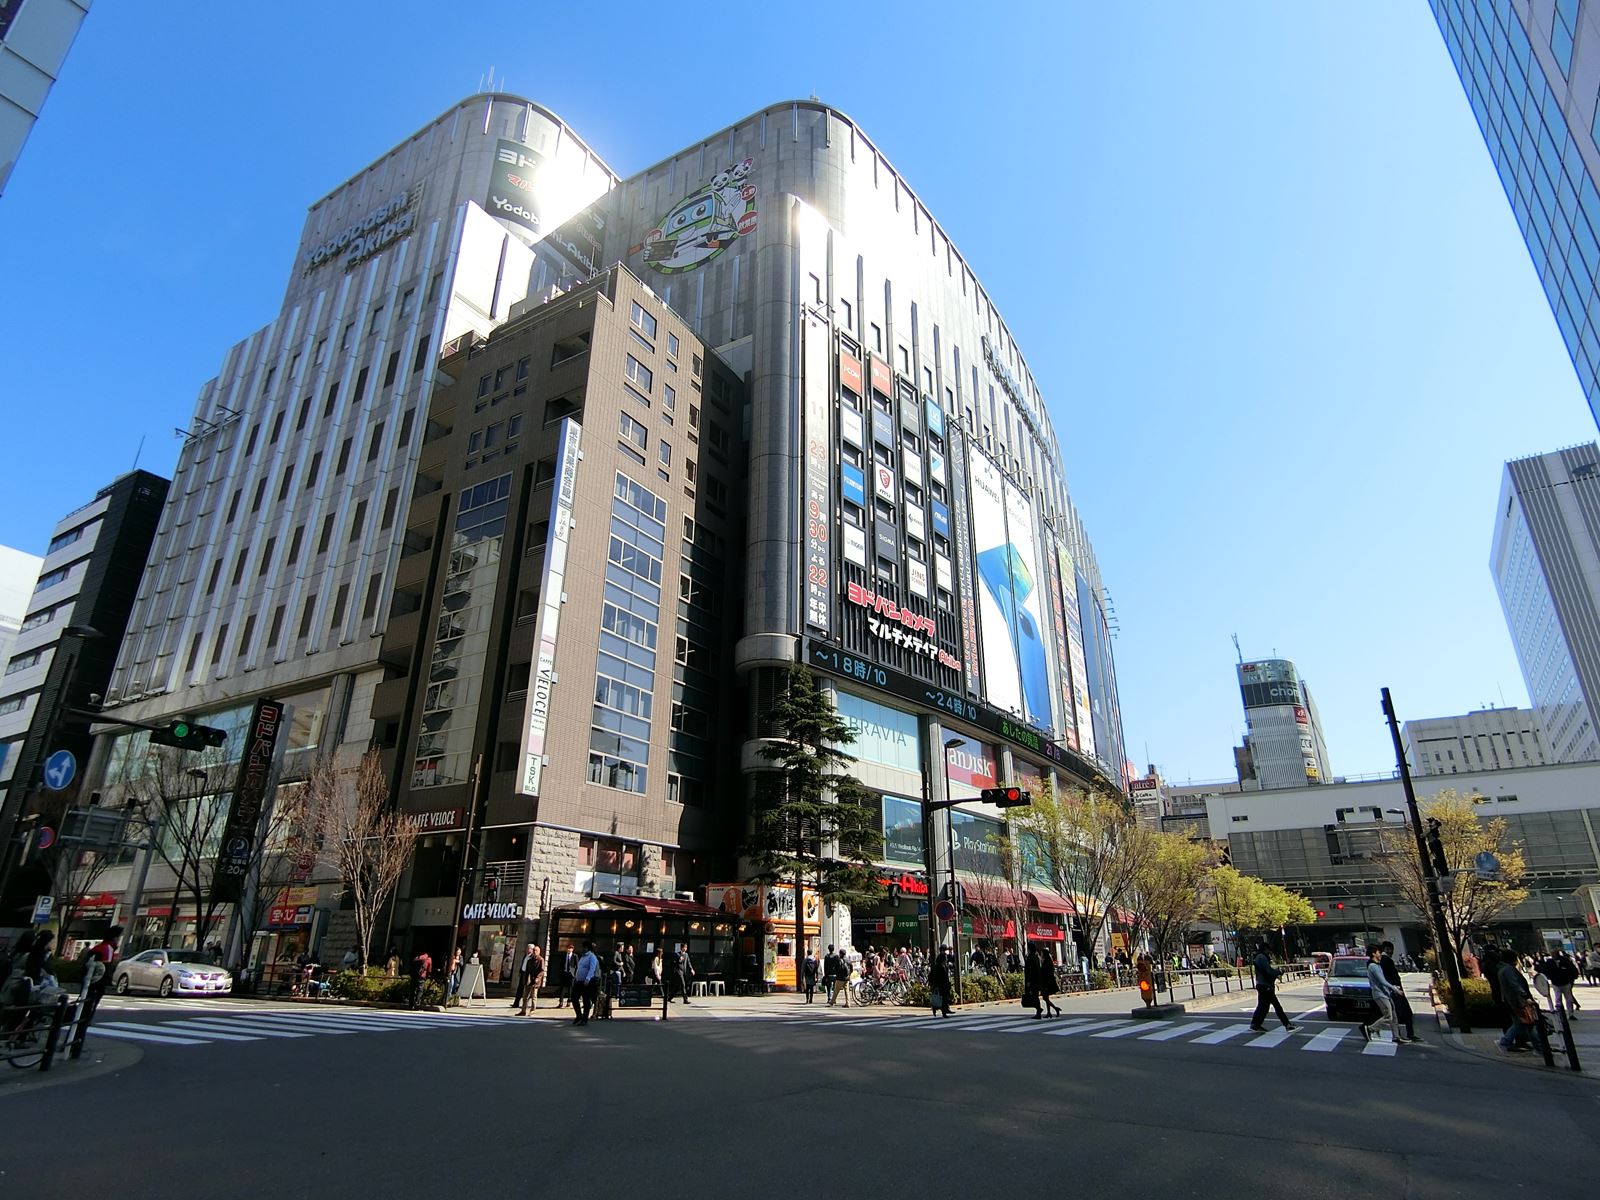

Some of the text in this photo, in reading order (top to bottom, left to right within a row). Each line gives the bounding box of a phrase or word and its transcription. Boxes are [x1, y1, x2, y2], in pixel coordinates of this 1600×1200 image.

[848, 581, 936, 638] ヨドバシカメラ
[867, 616, 939, 660] マルチメディア
[535, 669, 551, 717] VELOCE
[848, 715, 908, 747] BRAVIA
[943, 746, 993, 779] anDisk
[430, 810, 456, 827] VELOCE
[488, 901, 518, 919] VELOCE
